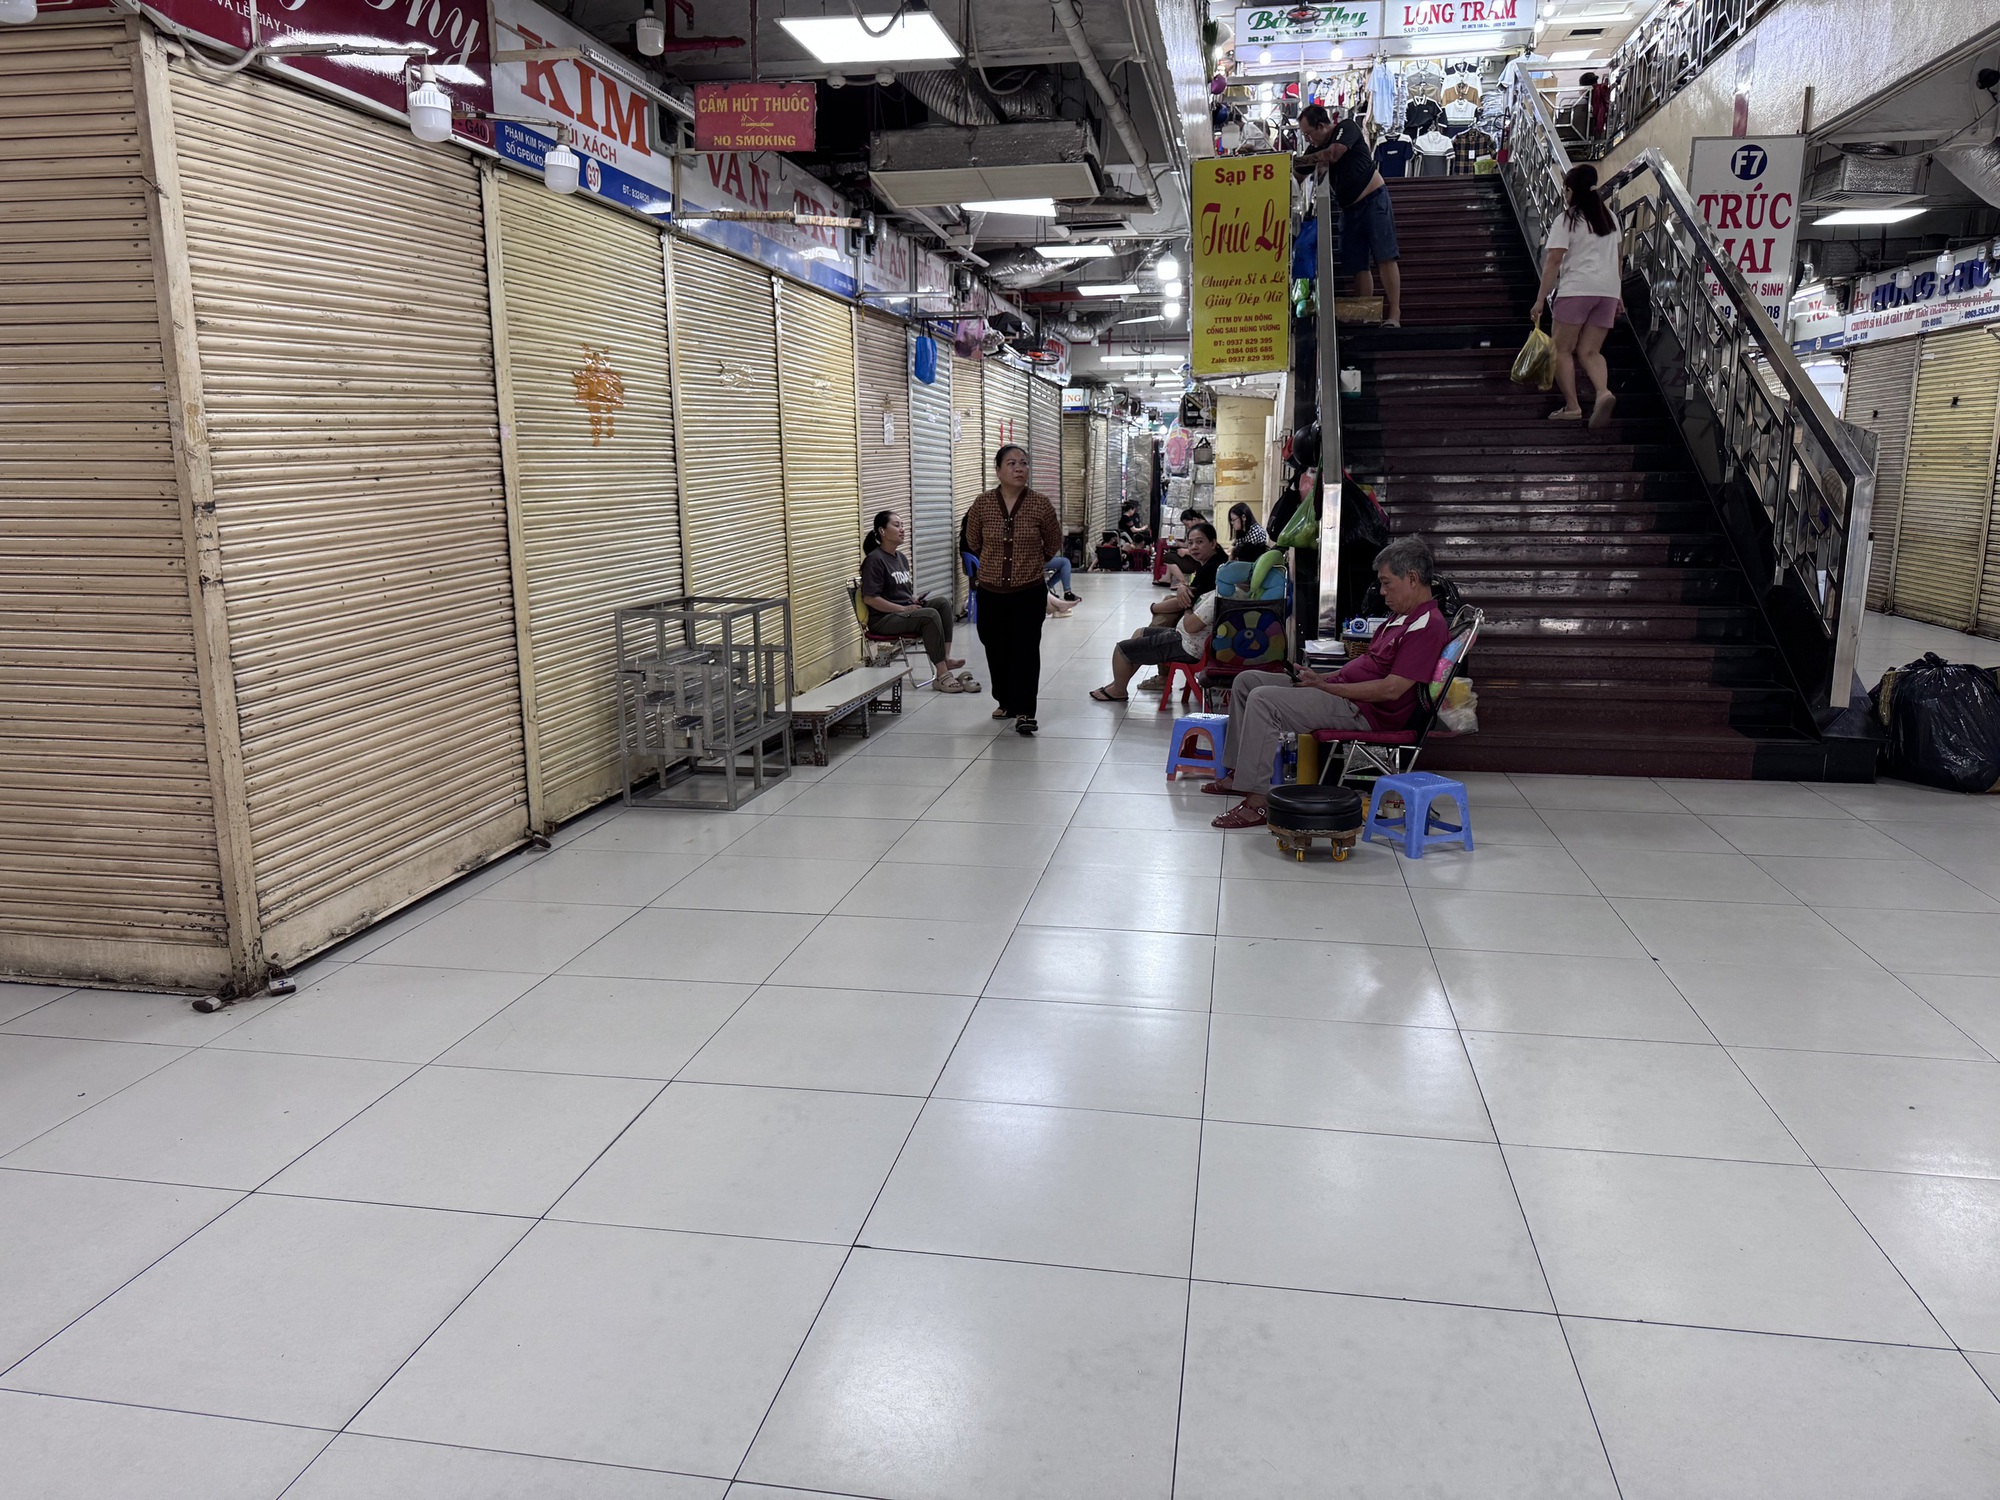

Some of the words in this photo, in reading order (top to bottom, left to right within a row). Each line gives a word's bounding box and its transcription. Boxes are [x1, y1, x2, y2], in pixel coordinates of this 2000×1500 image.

[256, 11, 281, 32] GIÀY
[1314, 6, 1369, 28] Thy
[516, 23, 652, 157] KIM
[699, 91, 728, 113] CẤM
[732, 93, 759, 113] HÚT
[763, 89, 810, 112] THUỐC
[465, 119, 486, 139] G40
[504, 125, 525, 143] PHẠM
[525, 133, 538, 149] KIM
[505, 139, 516, 156] SỐ
[582, 131, 617, 164] XÁCH
[713, 135, 731, 146] NO
[735, 135, 796, 146] SMOKING
[1734, 150, 1765, 176] F7
[586, 164, 600, 188] G37
[1215, 167, 1246, 187] Sạp
[1252, 164, 1275, 181] F8
[1697, 182, 1792, 230] TRÚC
[1200, 202, 1251, 257] Trúc
[1254, 198, 1288, 262] Ly
[1201, 275, 1242, 289] Chuyên
[1260, 273, 1267, 284] &
[1761, 283, 1784, 296] SINH
[1205, 293, 1232, 309] Giày
[1235, 292, 1261, 306] Dép
[1214, 316, 1232, 324] TTTM
[1233, 315, 1243, 323] DV
[1890, 310, 1903, 324] GIÀY
[1225, 326, 1238, 334] SAU
[1226, 338, 1243, 346] 0937
[1226, 347, 1243, 355] 0384
